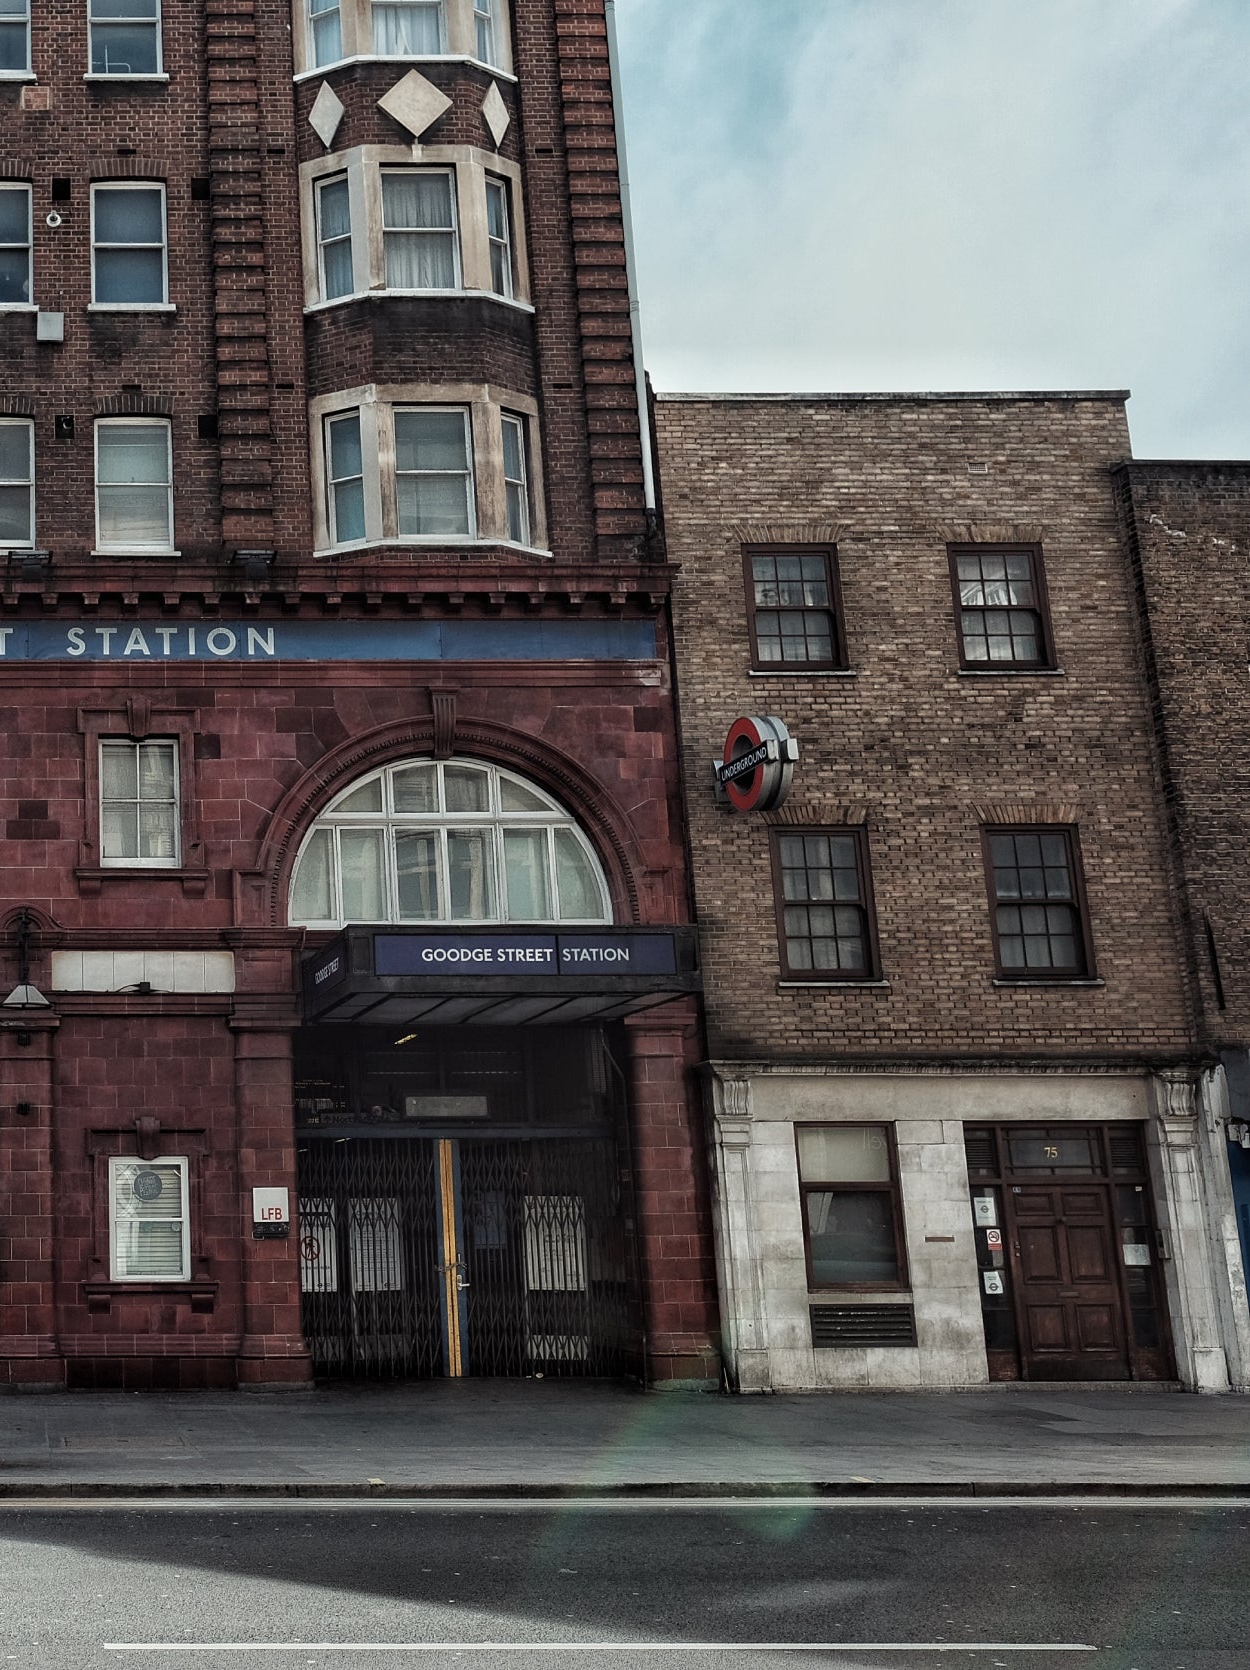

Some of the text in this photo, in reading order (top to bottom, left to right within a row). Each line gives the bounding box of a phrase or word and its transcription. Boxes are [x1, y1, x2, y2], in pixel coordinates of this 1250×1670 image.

[66, 627, 275, 656] STATION
[721, 746, 767, 781] UNDERGROUND
[421, 948, 630, 962] GOODGE STREET STATION
[1044, 1147, 1058, 1158] 75
[261, 1207, 283, 1221] LFB
